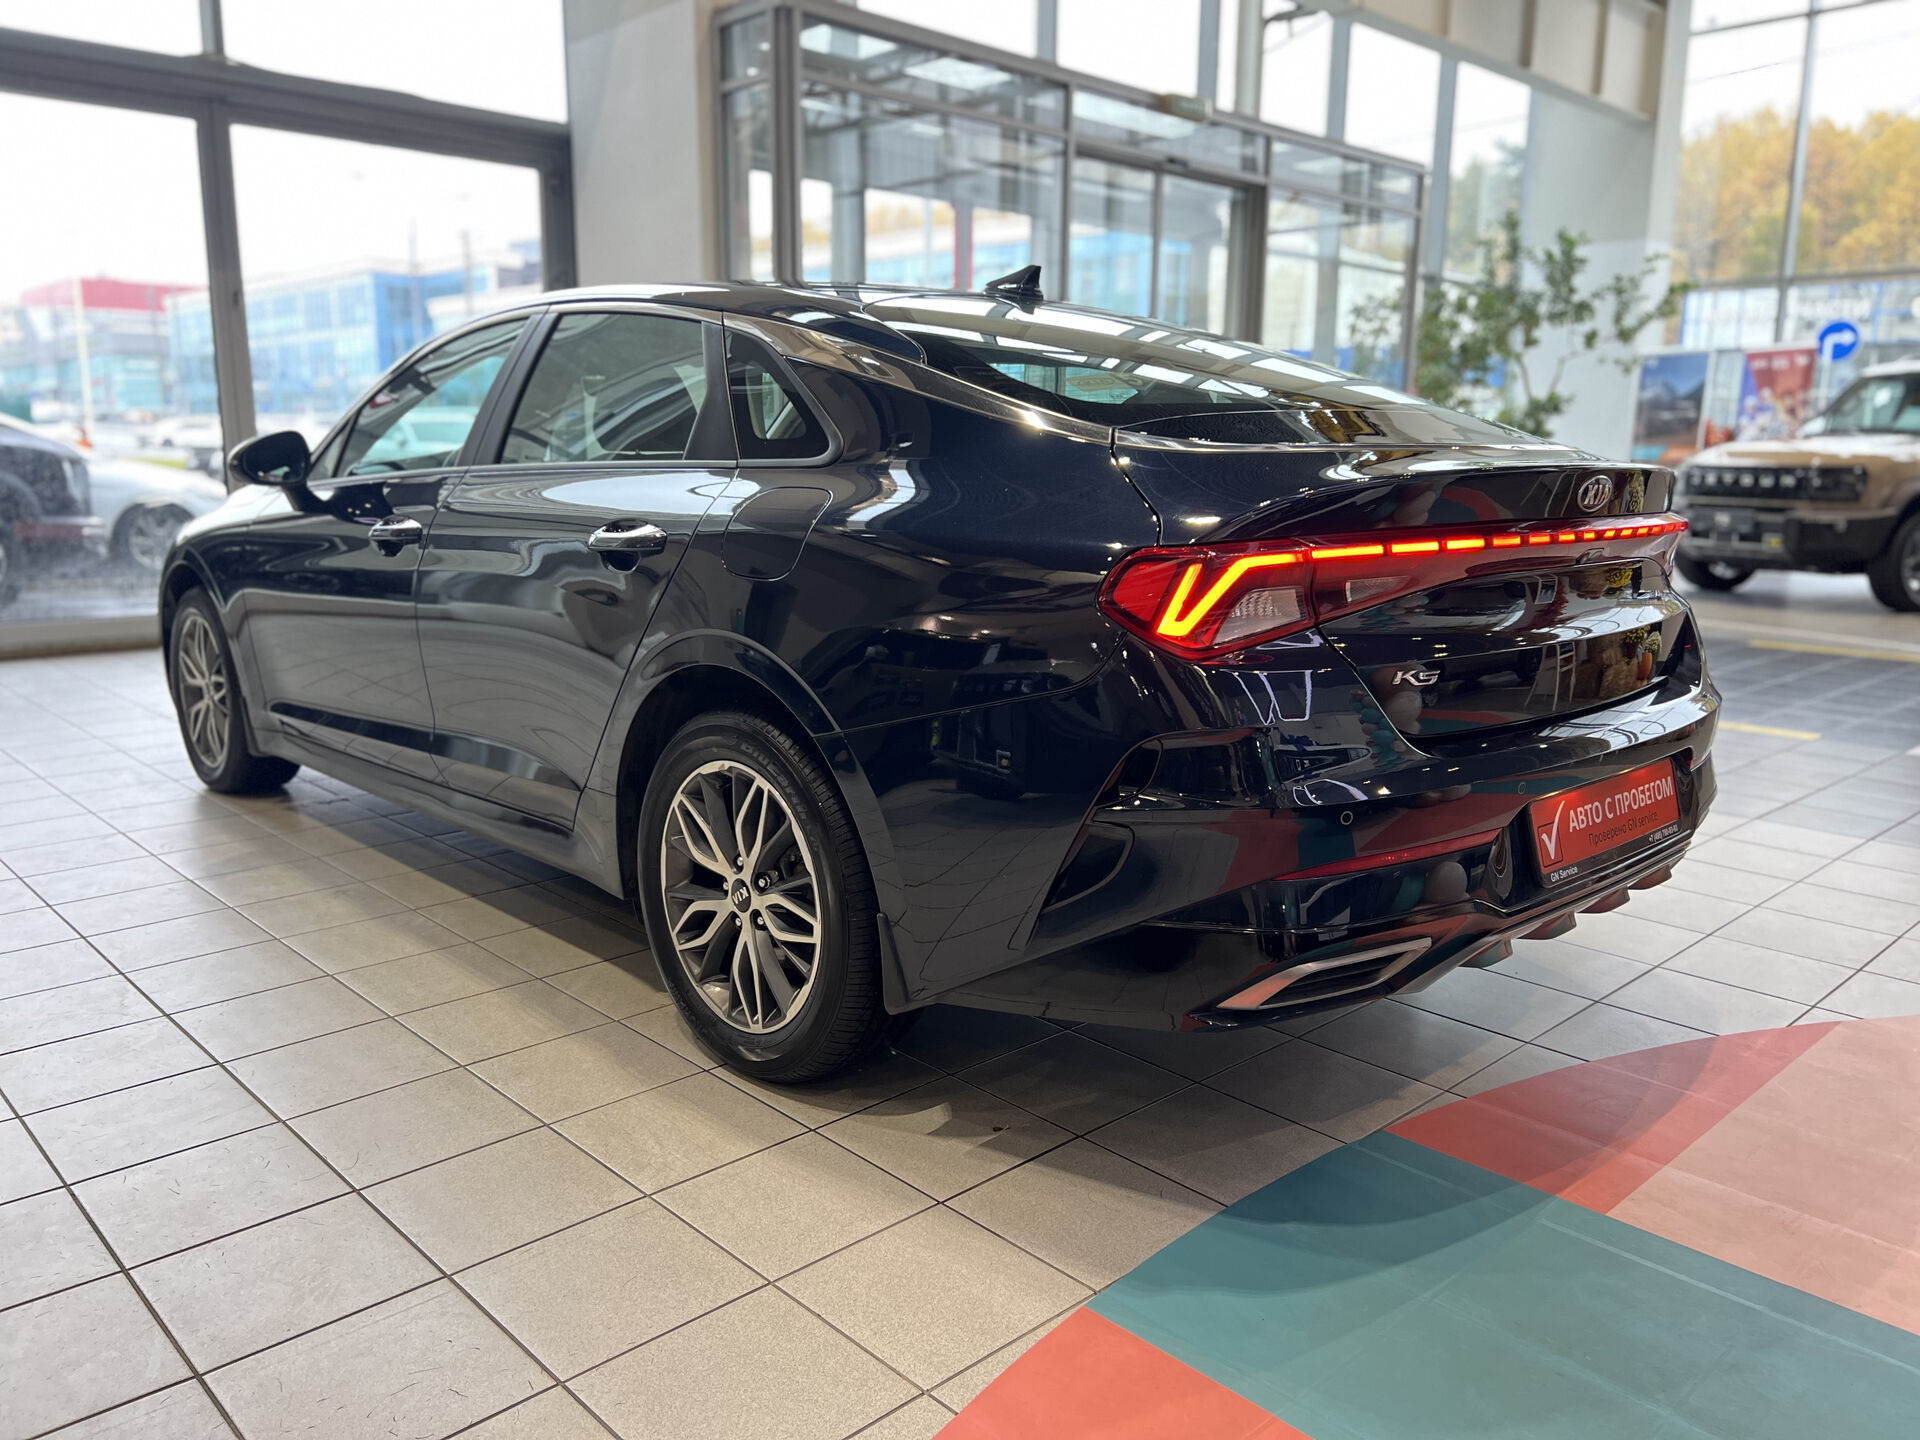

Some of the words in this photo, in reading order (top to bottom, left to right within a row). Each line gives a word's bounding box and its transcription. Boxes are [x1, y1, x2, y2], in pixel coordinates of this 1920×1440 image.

[1391, 669, 1441, 686] K5
[1569, 801, 1603, 833] АВТО
[1605, 798, 1614, 819] С
[1615, 776, 1674, 816] ПРОБЕГОМ
[1588, 823, 1627, 847] Проверено
[1550, 871, 1560, 882] GN
[1559, 866, 1578, 879] Service
[732, 886, 749, 905] KIA
